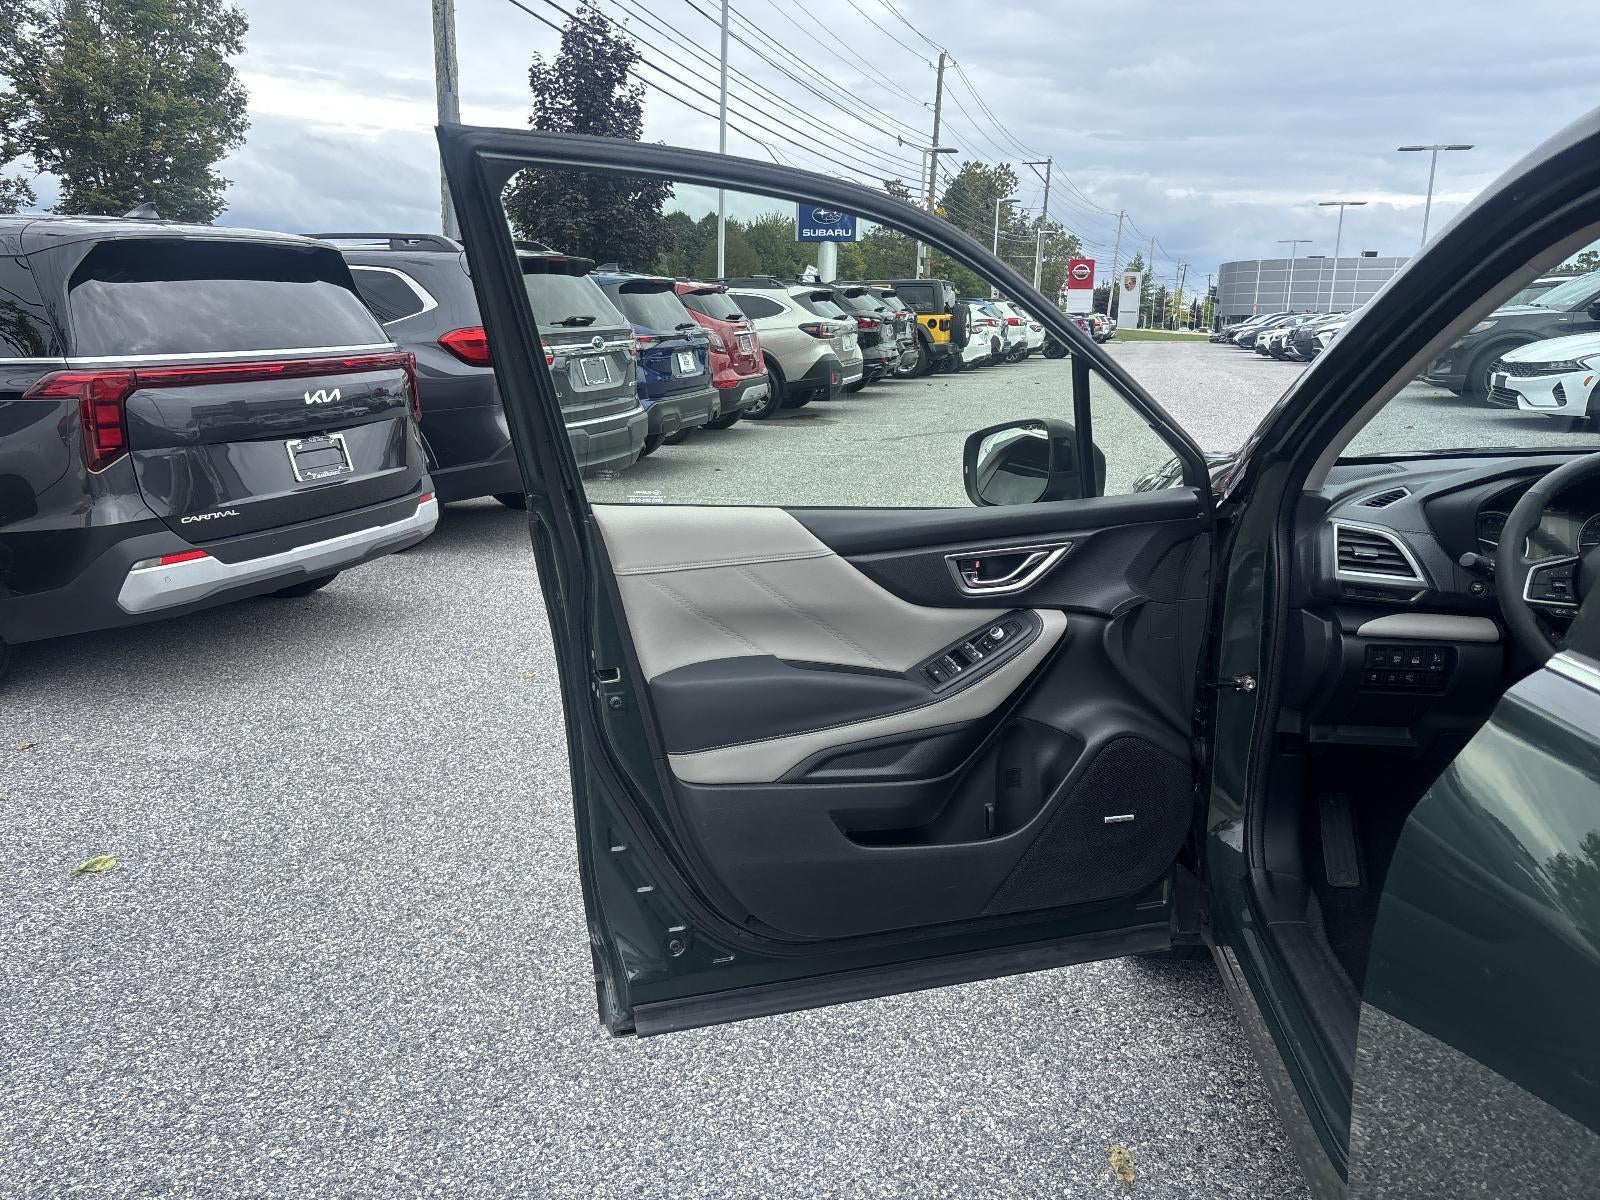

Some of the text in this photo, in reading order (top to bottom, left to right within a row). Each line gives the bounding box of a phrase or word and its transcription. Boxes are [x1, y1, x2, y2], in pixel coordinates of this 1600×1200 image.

[802, 229, 852, 237] SUBARU
[304, 388, 341, 404] KIA
[181, 509, 240, 524] CARNIVAL
